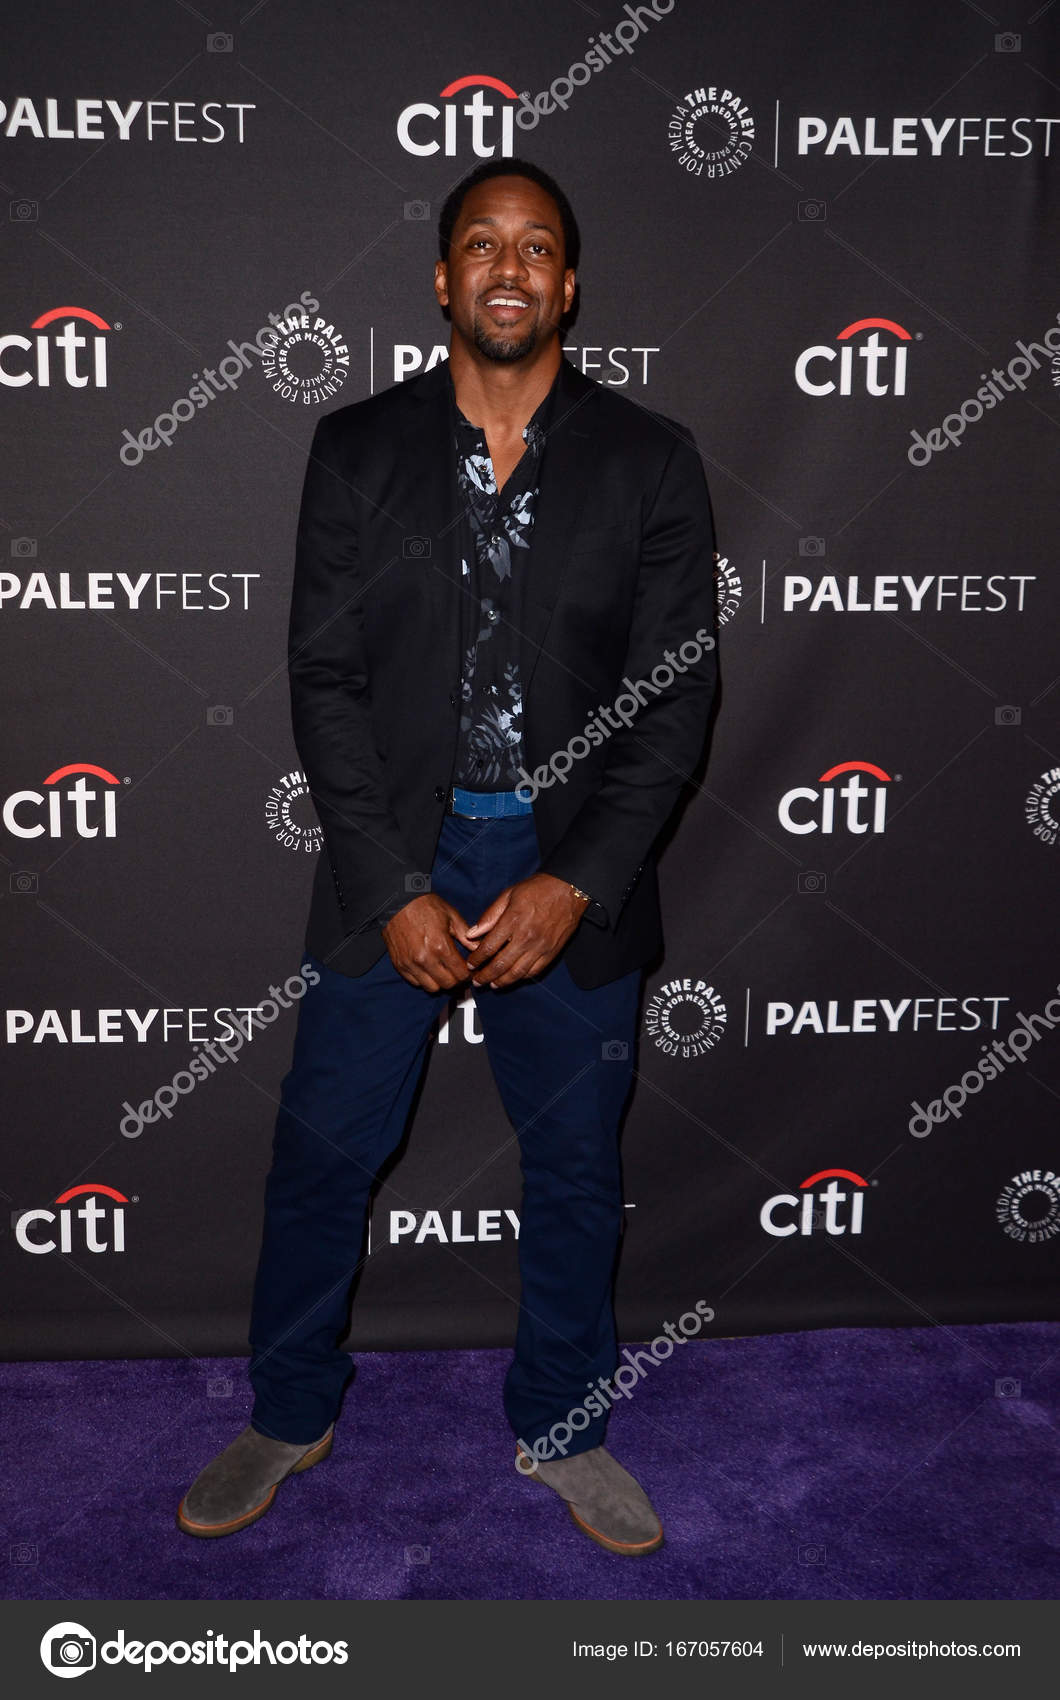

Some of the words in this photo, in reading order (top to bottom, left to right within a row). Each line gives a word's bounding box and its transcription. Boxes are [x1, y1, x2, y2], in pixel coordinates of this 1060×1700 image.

[684, 87, 717, 107] THE
[691, 105, 709, 121] FOR
[720, 89, 755, 139] PALEY
[0, 98, 256, 143] ALEYFEST
[397, 90, 514, 158] citi
[668, 106, 689, 152] MEDIA
[711, 104, 738, 129] MEDIA
[685, 121, 705, 159] CENTER
[798, 117, 1060, 157] PALEYFEST
[678, 152, 703, 176] FOR
[707, 141, 753, 178] CENTER
[277, 315, 310, 335] THE
[284, 333, 302, 348] FOR
[314, 317, 350, 366] PALEY
[0, 321, 108, 388] citi
[261, 334, 282, 379] MEDIA
[304, 332, 332, 357] MEDIA
[278, 349, 299, 385] CENTER
[794, 332, 908, 397] citi
[272, 379, 298, 402] FOR
[303, 368, 348, 405] CENTER
[0, 572, 261, 611] PALEYFEST
[783, 575, 1037, 612] PALEYFEST
[2, 776, 117, 839] citi
[265, 788, 285, 829] MEDIA
[287, 787, 304, 801] FOR
[778, 774, 887, 835] citi
[276, 829, 300, 850] FOR
[660, 978, 691, 997] THE
[666, 995, 684, 1009] FOR
[685, 994, 711, 1015] MEDIA
[694, 980, 727, 1023] PALEY
[6, 1007, 264, 1044] PALEYFEST
[645, 995, 665, 1036] MEDIA
[767, 997, 1010, 1035] PALEYFEST
[655, 1035, 679, 1056] FOR
[682, 1025, 725, 1058] CENTER
[1012, 1170, 1041, 1187] THE
[15, 1195, 126, 1255] citi
[761, 1180, 865, 1237] citi
